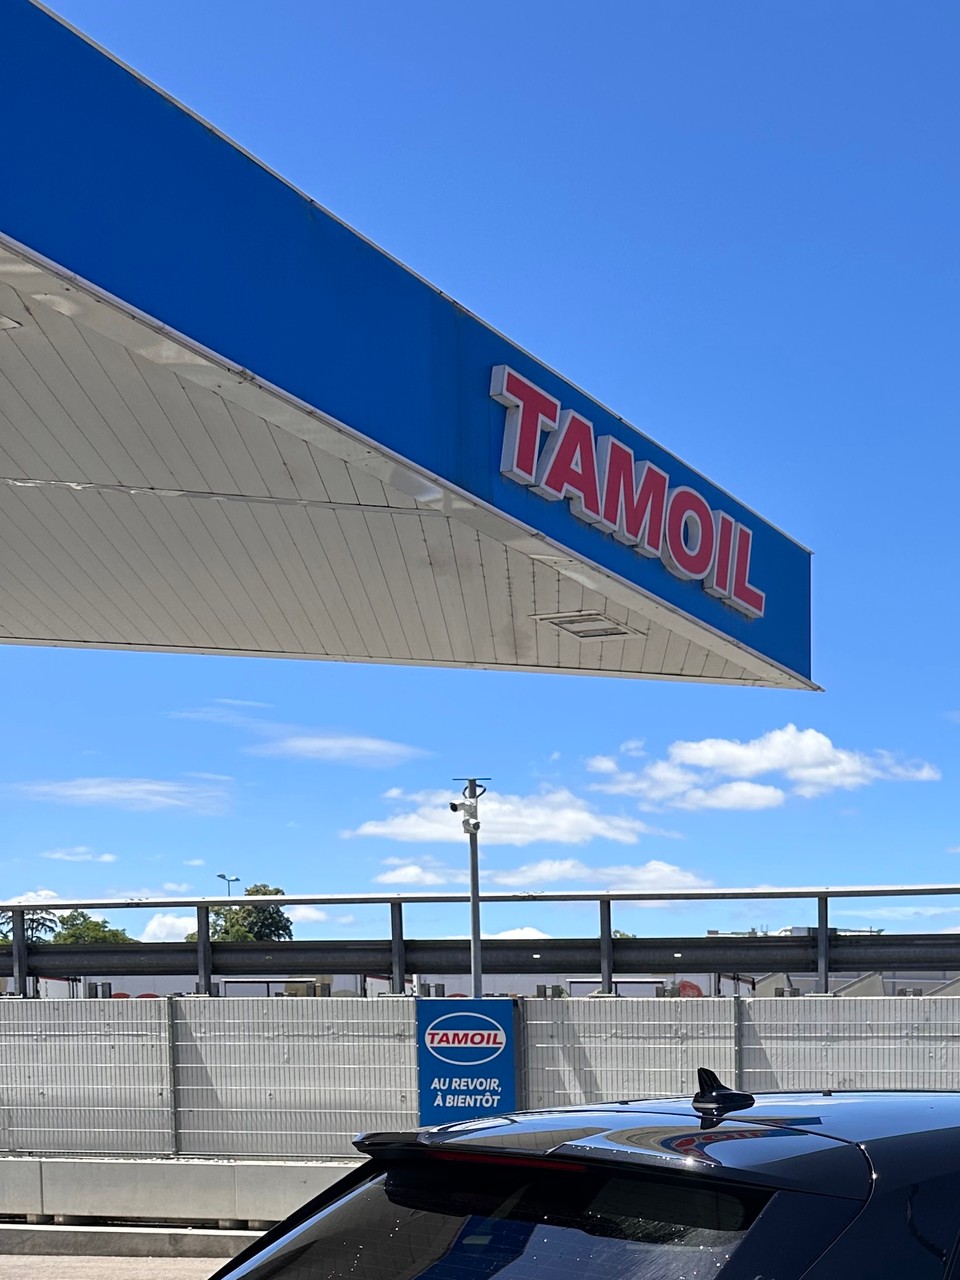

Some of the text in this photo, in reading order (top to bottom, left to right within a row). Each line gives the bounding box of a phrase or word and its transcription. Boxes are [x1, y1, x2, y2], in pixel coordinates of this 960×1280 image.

[491, 364, 765, 618] TAMOIL
[427, 1032, 504, 1045] TAMOIL
[430, 1078, 502, 1092] AU REVOIR,
[433, 1092, 501, 1108] À BIENTÔT
